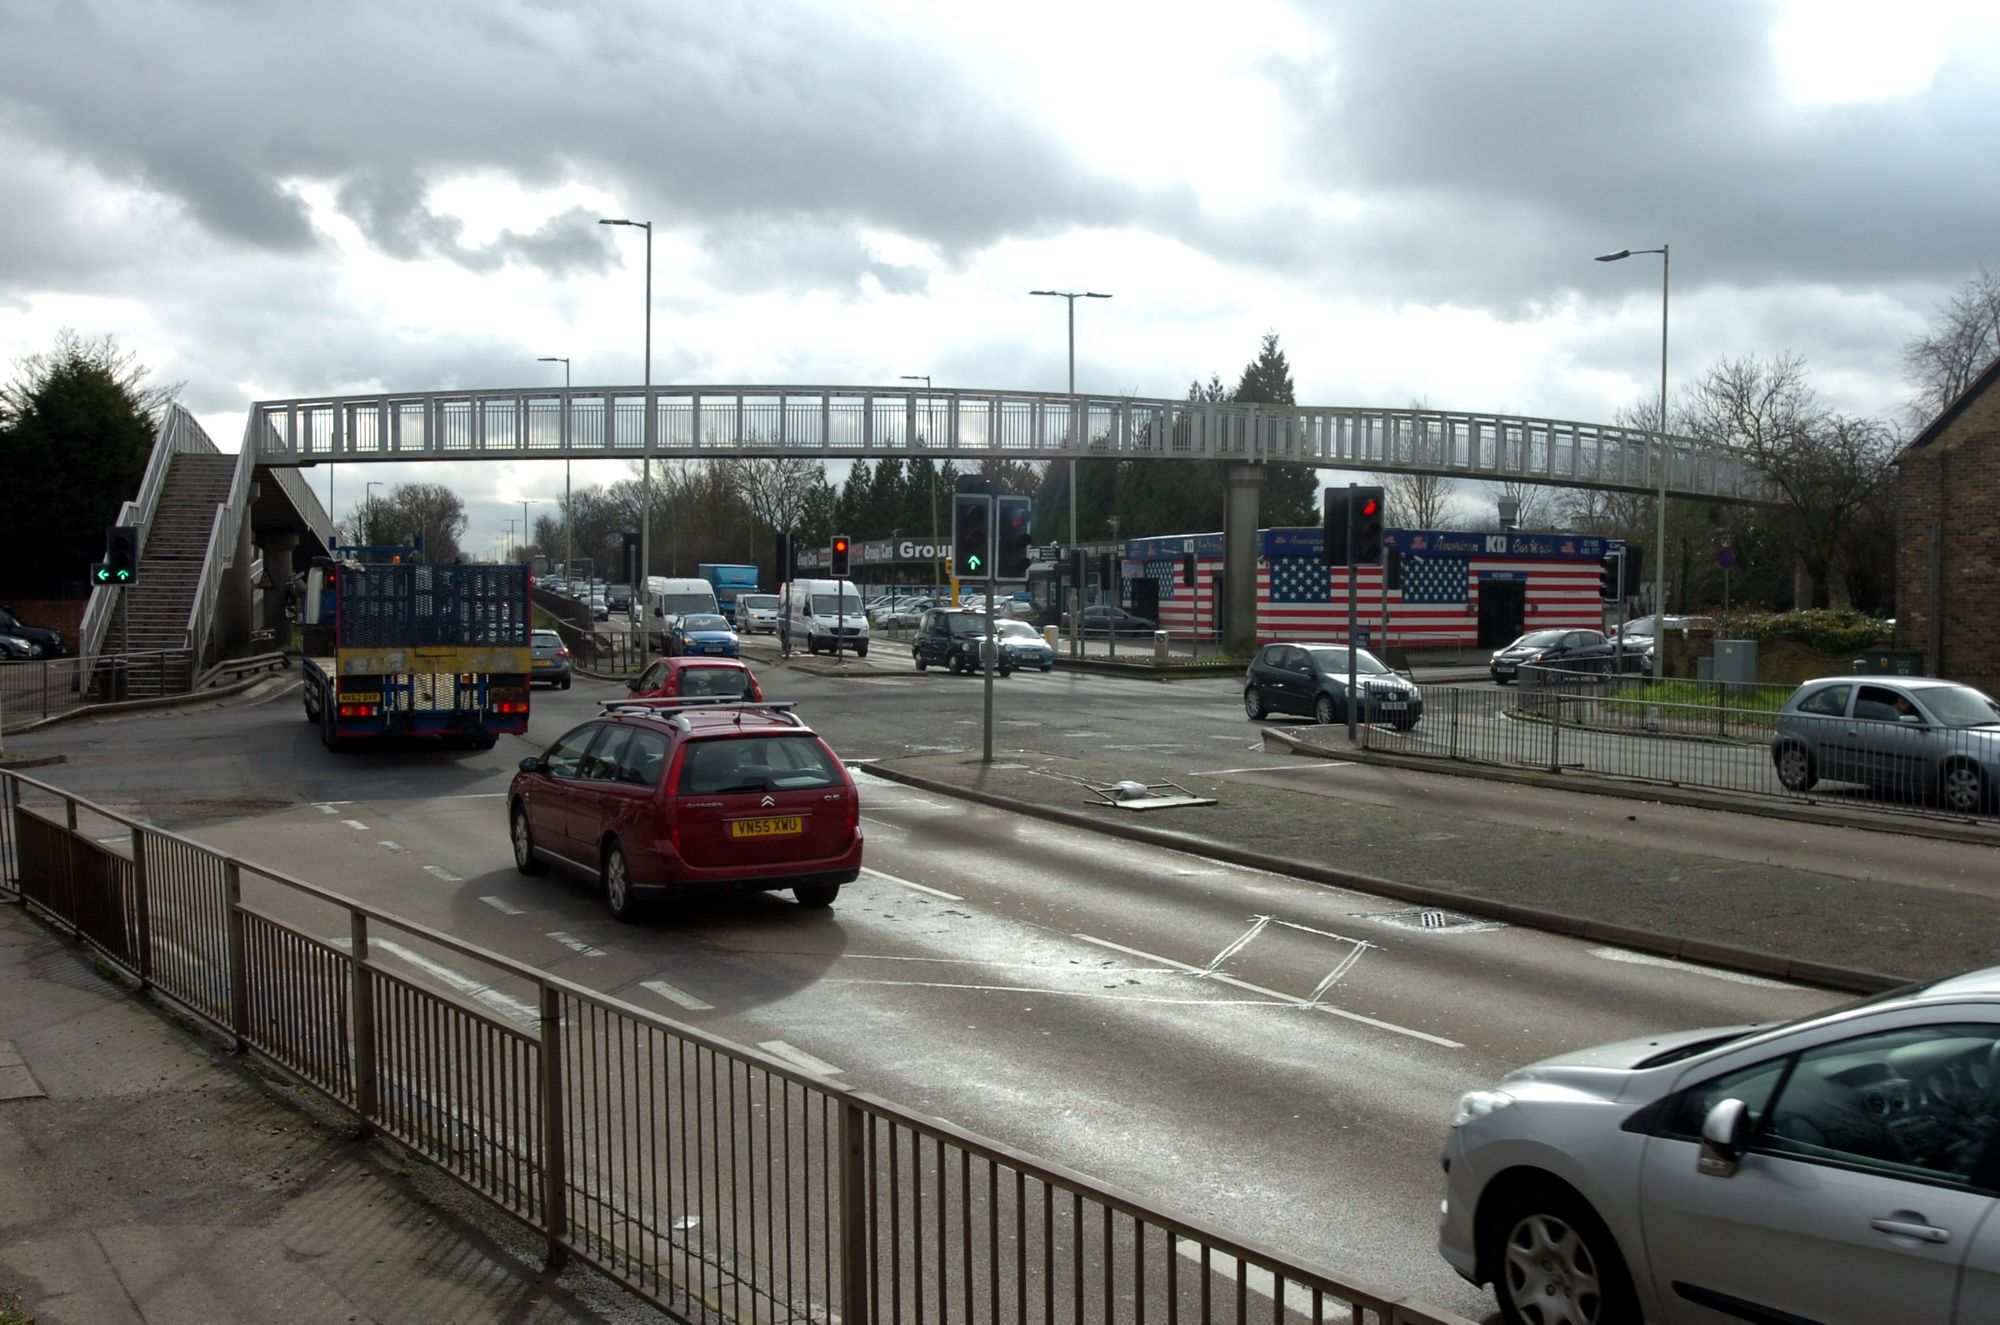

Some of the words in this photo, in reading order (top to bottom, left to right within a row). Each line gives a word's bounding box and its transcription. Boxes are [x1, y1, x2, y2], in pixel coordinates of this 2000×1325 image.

[899, 541, 953, 558] Grou
[738, 820, 770, 834] VN55
[774, 818, 798, 832] XWU
